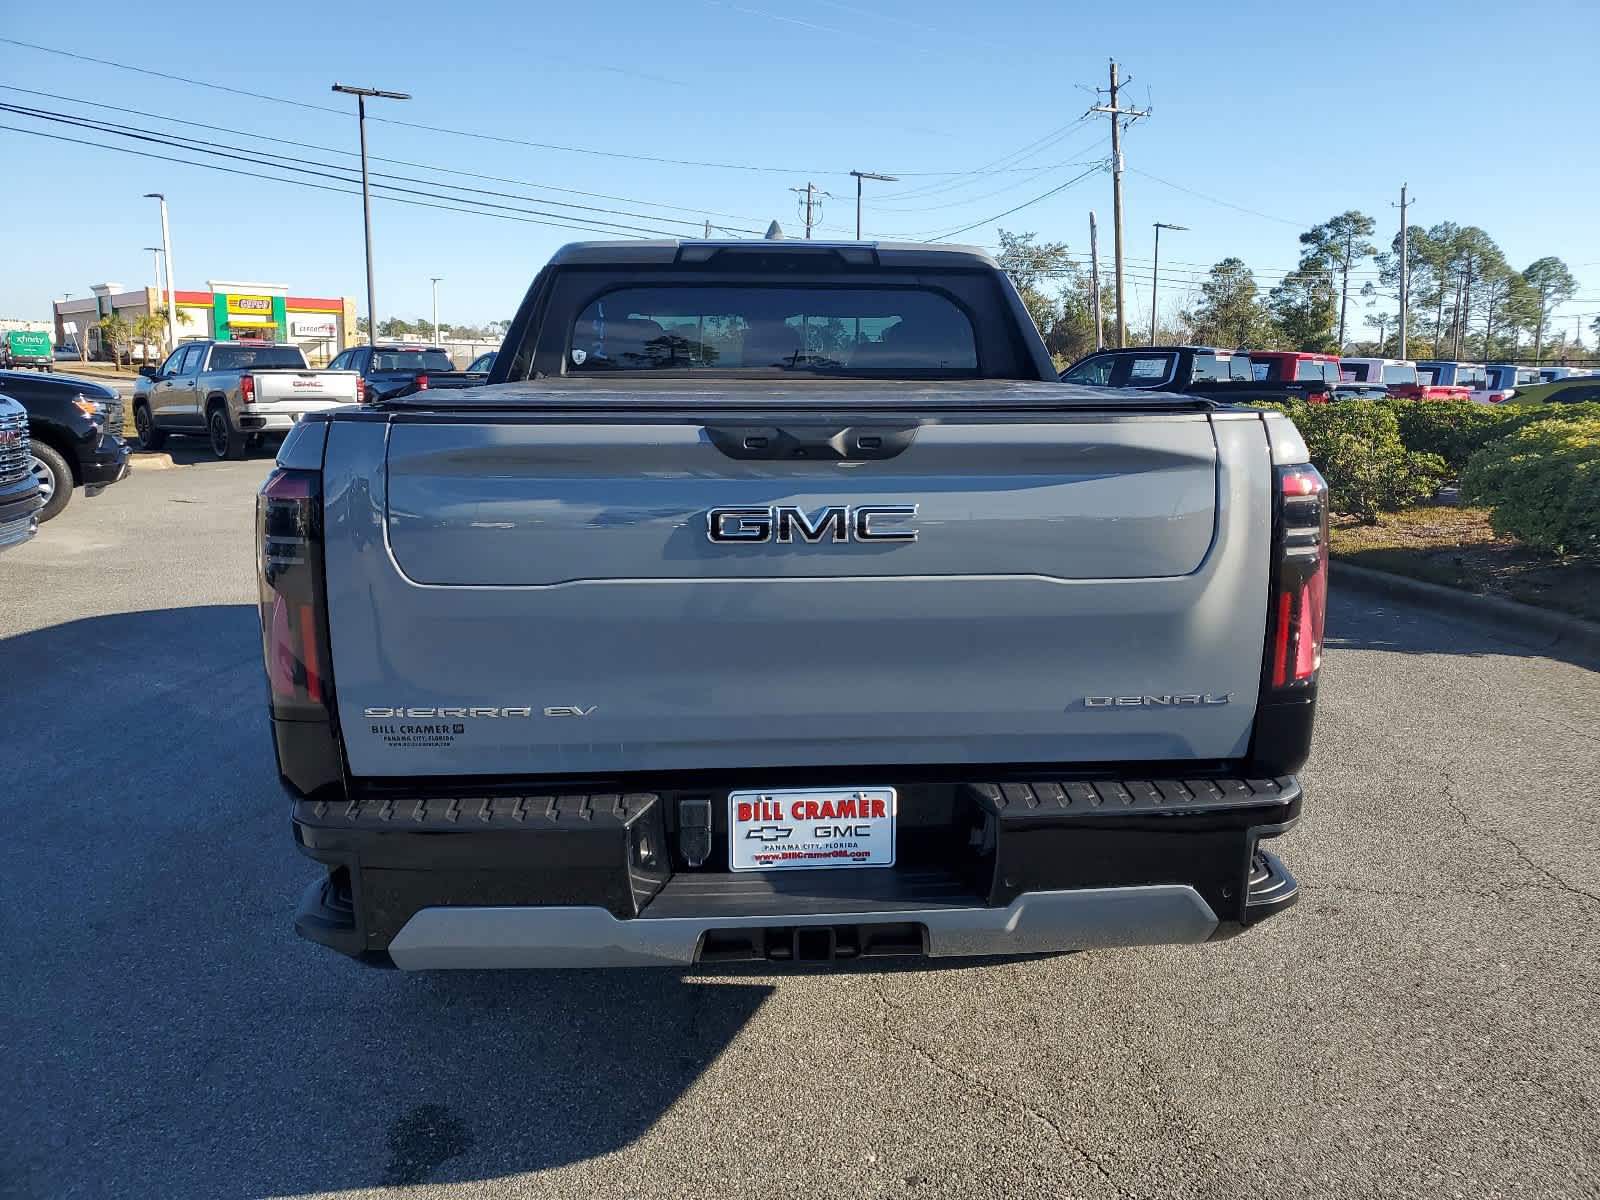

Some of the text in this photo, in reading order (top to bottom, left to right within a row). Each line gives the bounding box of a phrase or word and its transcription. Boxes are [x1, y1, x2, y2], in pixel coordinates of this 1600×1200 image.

[16, 335, 44, 344] xfinity
[706, 505, 919, 544] GMC
[1084, 693, 1234, 706] DENALI
[364, 705, 598, 718] SIERRA EV
[371, 725, 395, 734] BILL
[400, 725, 449, 734] CRAMER
[738, 799, 886, 821] BILL CRAMER
[815, 825, 870, 837] GMC
